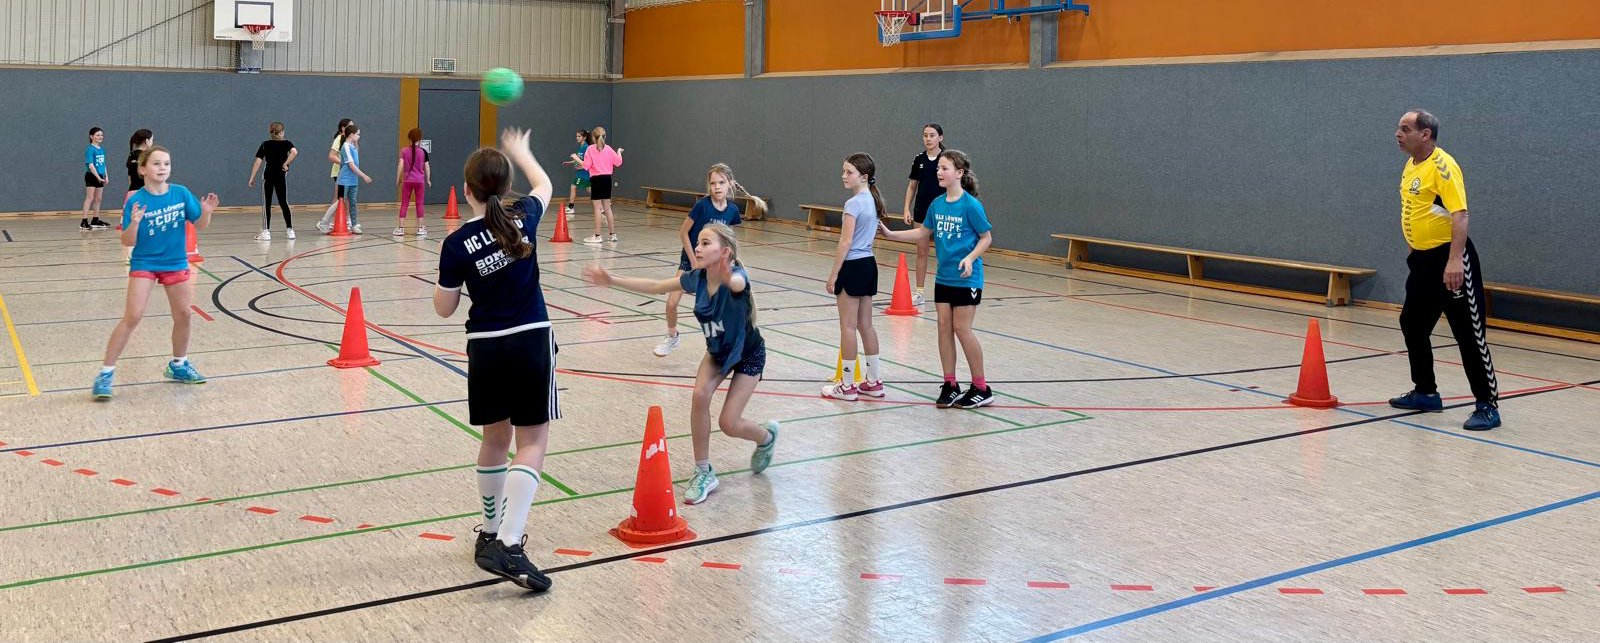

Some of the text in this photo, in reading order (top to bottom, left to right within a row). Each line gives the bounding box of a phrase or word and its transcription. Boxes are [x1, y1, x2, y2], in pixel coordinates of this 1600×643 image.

[155, 210, 179, 226] CUP
[937, 220, 955, 231] CUP
[463, 235, 482, 254] HC
